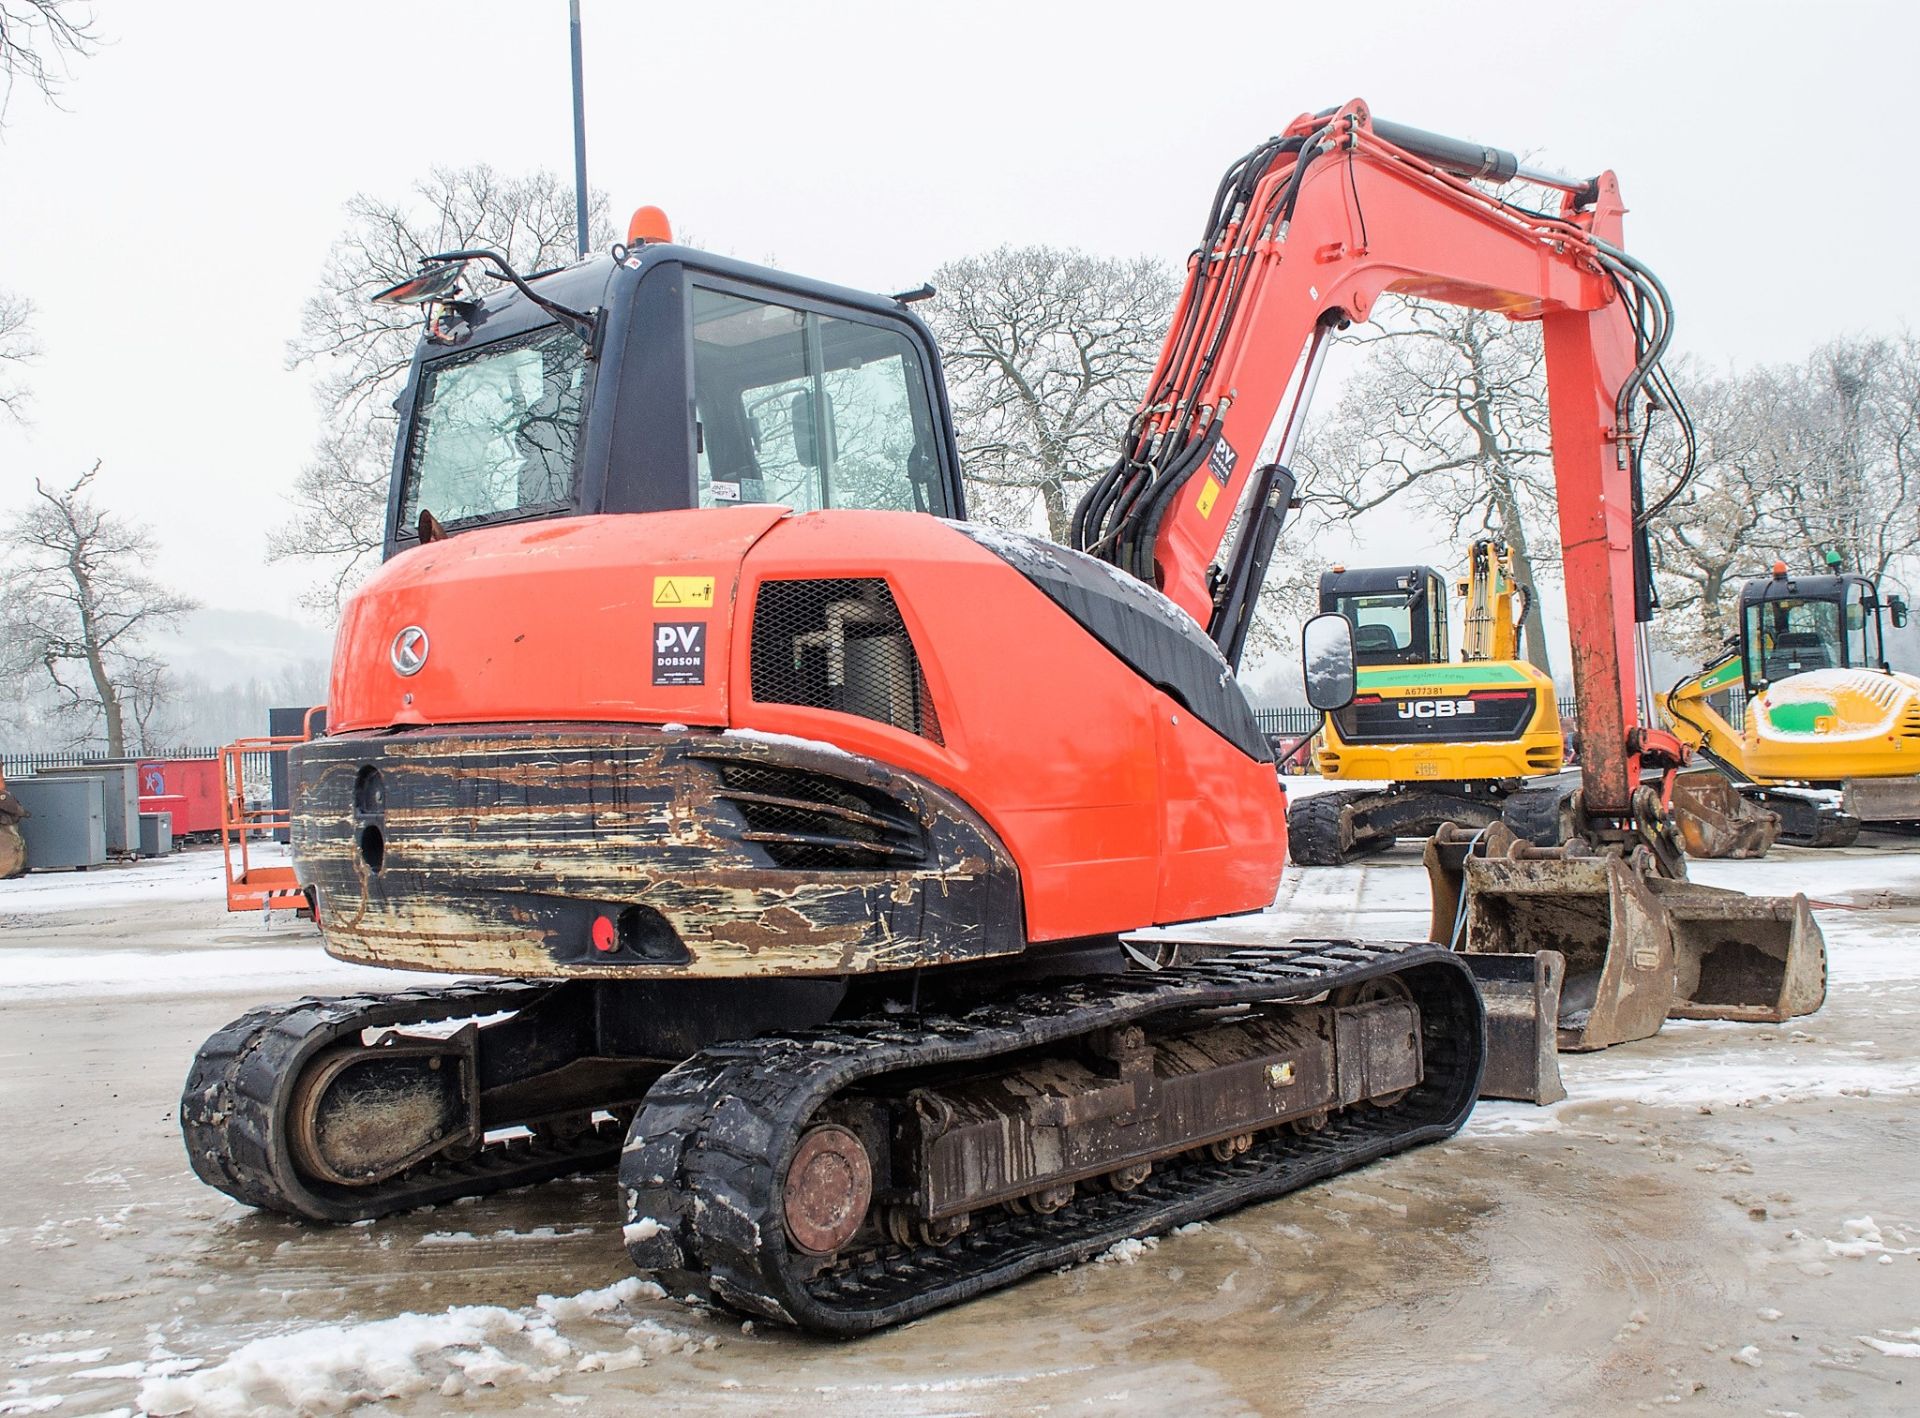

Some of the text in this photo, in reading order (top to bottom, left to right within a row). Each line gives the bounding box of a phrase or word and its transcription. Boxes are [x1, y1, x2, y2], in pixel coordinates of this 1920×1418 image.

[656, 626, 701, 653] P.V.
[657, 657, 700, 666] DOBSON
[1405, 687, 1443, 696] A677381
[1398, 700, 1457, 719] JCB
